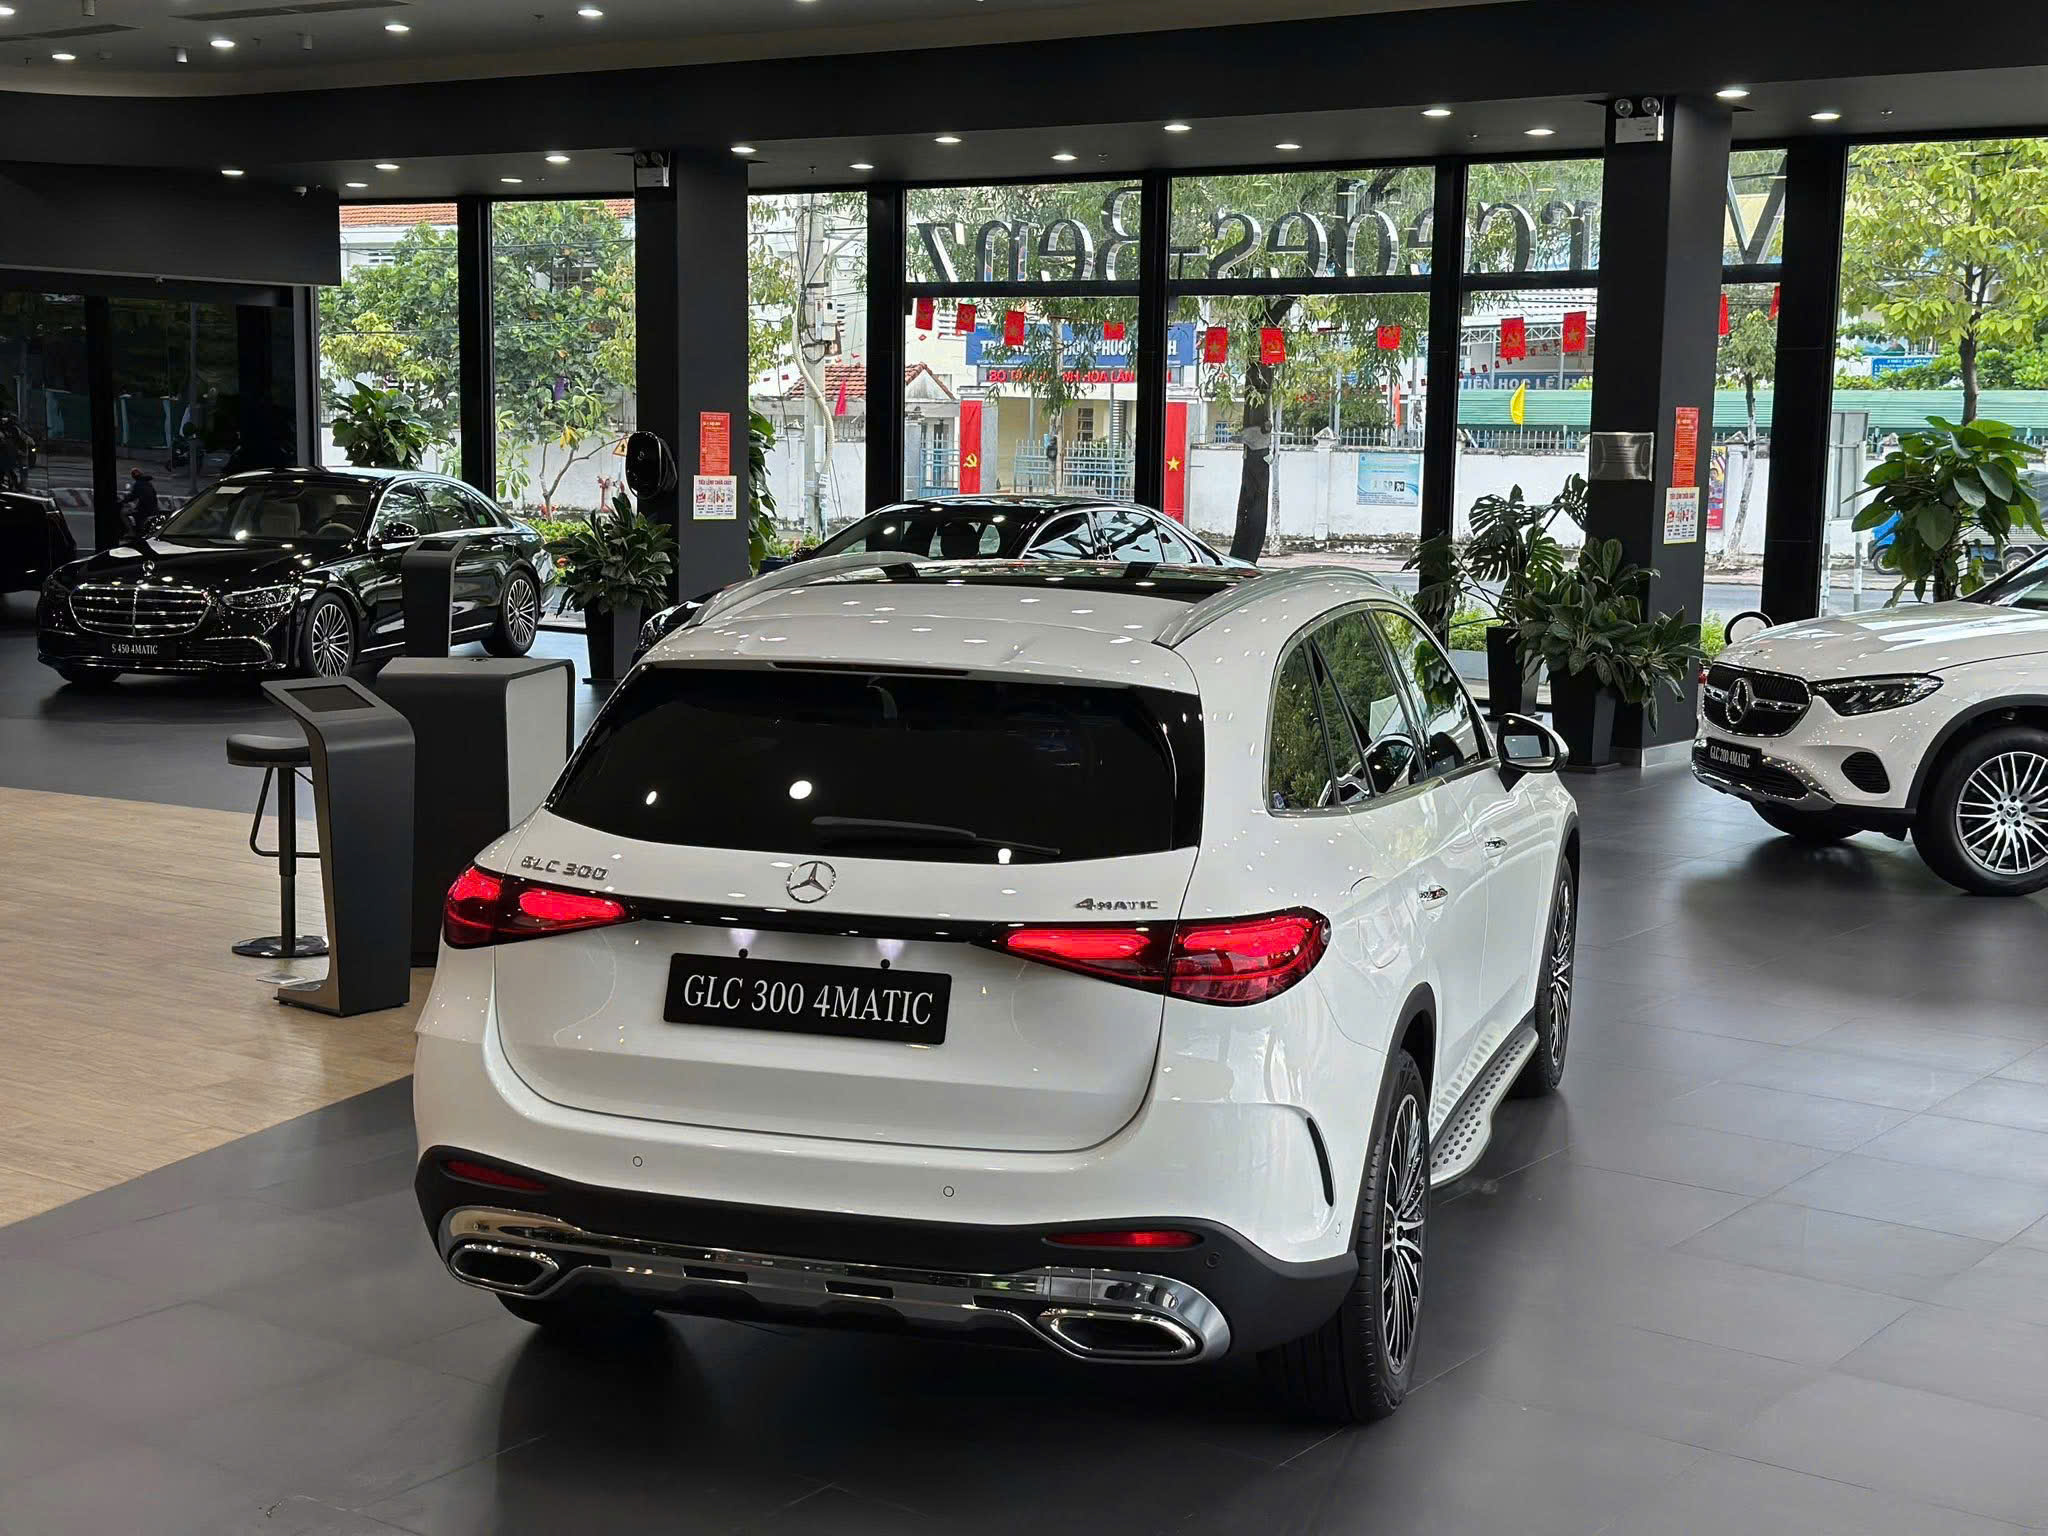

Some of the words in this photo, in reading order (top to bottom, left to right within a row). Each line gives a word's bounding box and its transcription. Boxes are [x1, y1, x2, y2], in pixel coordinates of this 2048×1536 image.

[118, 643, 130, 653] 450
[521, 855, 561, 873] GLC
[562, 862, 609, 881] 300
[1074, 897, 1159, 911] 4MATIC
[684, 974, 743, 1010] GLC
[751, 979, 805, 1015] 300
[813, 984, 933, 1026] 4MATIC
